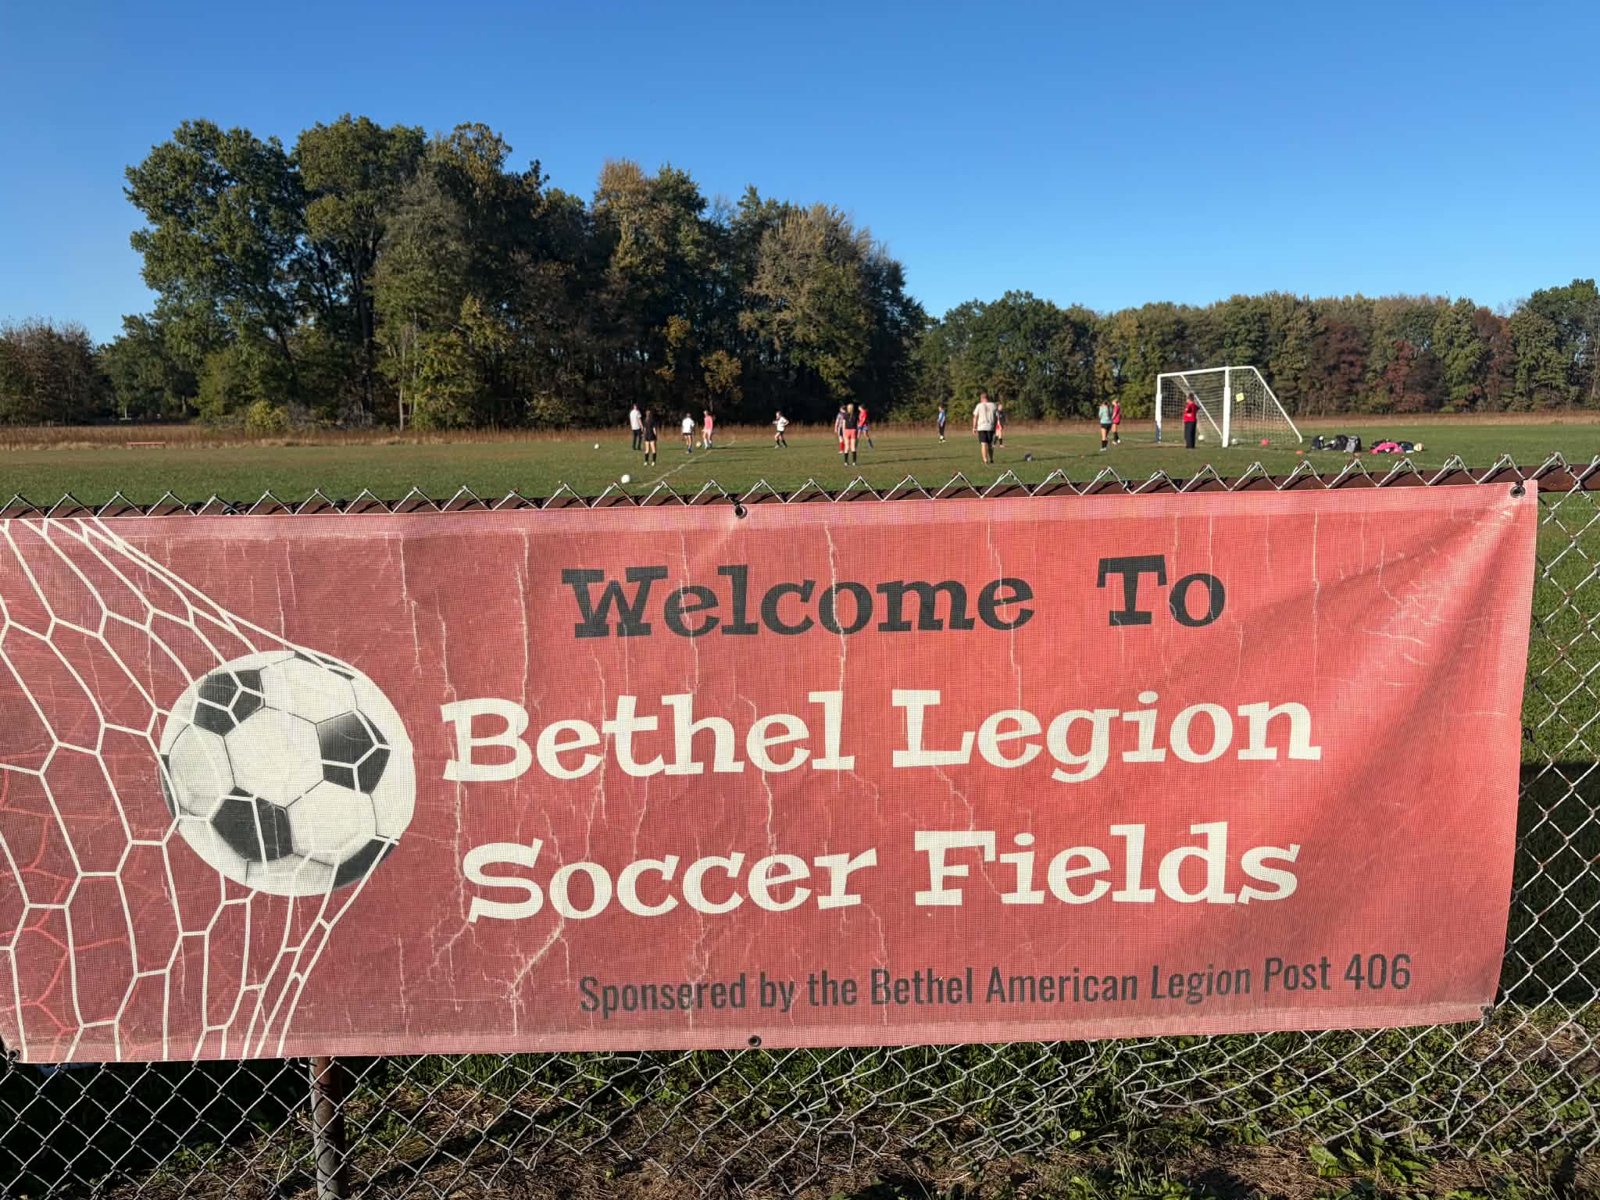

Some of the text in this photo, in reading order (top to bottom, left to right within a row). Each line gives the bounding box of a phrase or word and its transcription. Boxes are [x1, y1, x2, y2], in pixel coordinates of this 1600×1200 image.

[561, 554, 1225, 638] Welcome To
[440, 689, 1321, 783] Bethel Legion
[463, 821, 1300, 923] Soccer Fields
[579, 953, 1411, 1019] Sponsered by the Bethel American Legion Post 406
